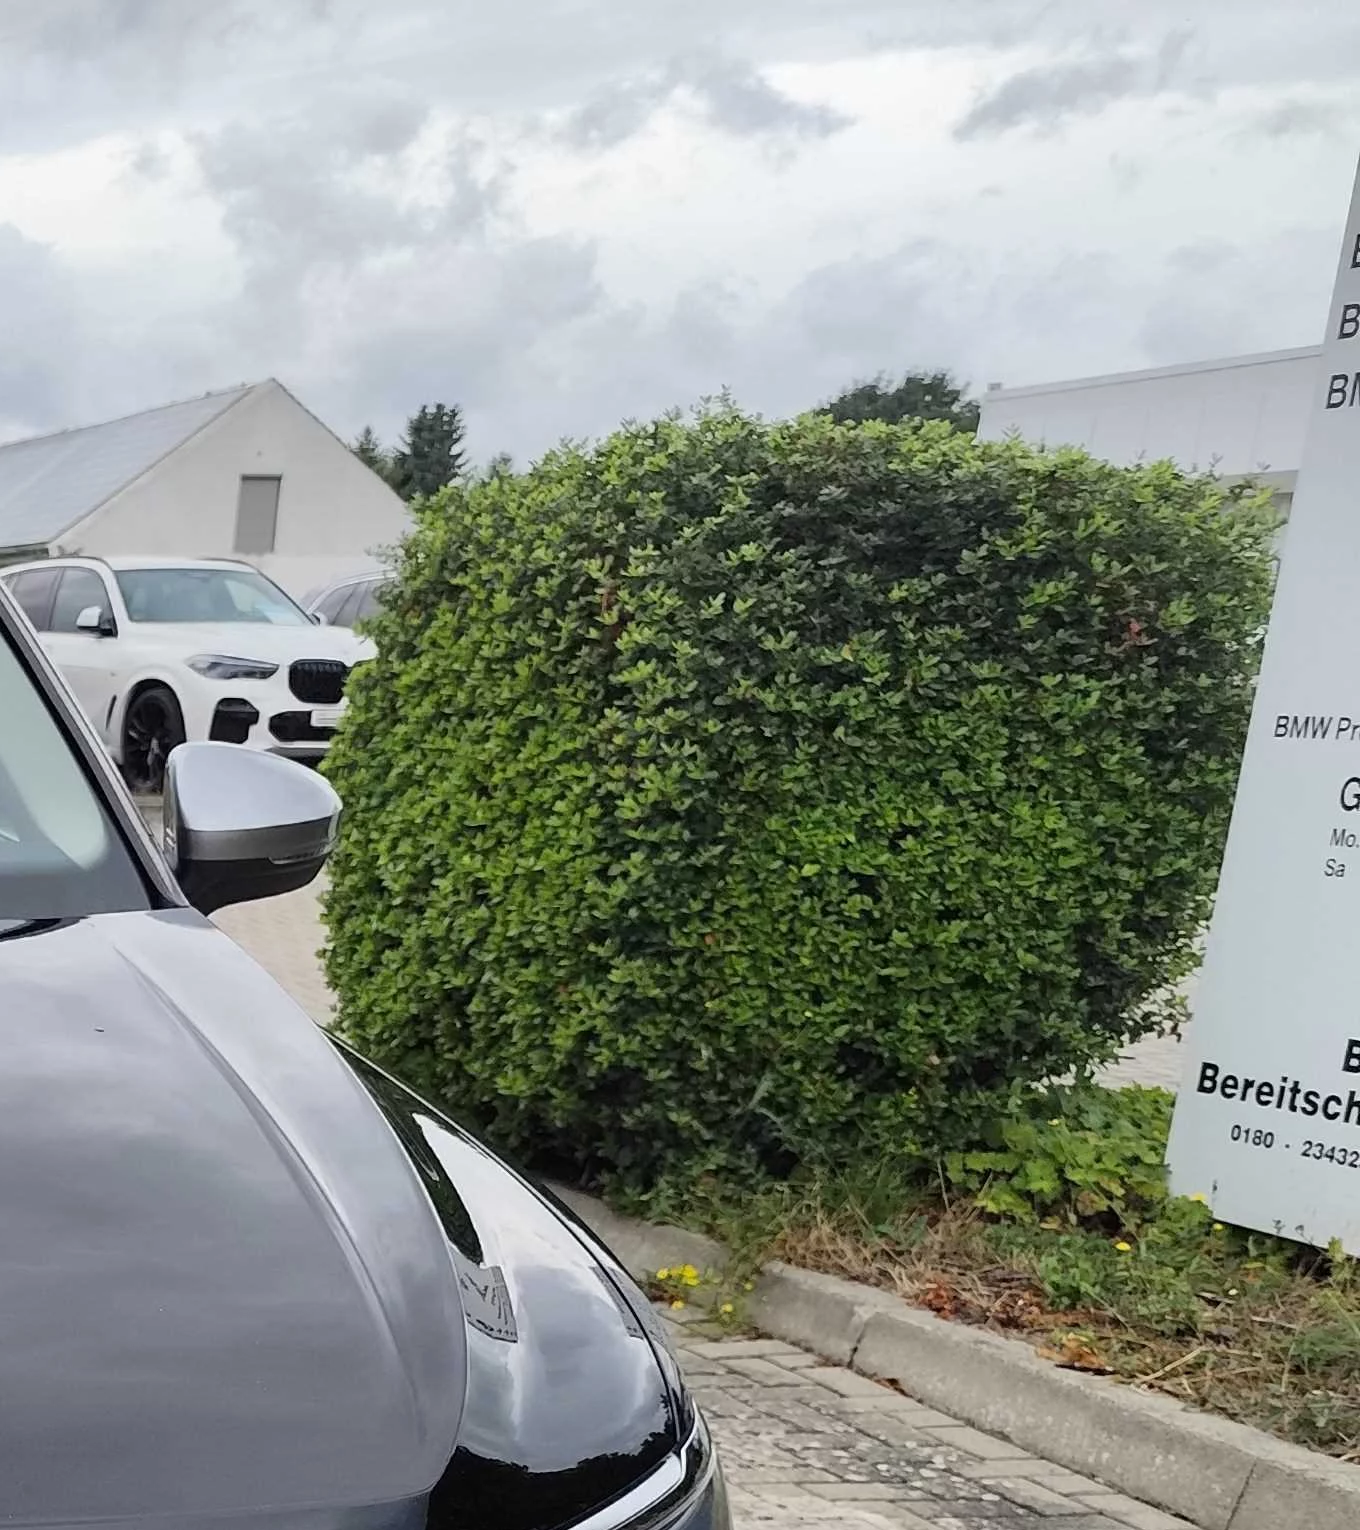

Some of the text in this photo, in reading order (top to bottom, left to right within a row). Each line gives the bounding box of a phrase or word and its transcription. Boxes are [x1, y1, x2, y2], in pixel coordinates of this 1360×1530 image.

[1273, 715, 1360, 742] BMW Pr
[1340, 777, 1360, 812] G
[1323, 858, 1346, 878] Sa
[1197, 1061, 1360, 1127] Bereitsch
[1230, 1124, 1360, 1169] 0180 23432
